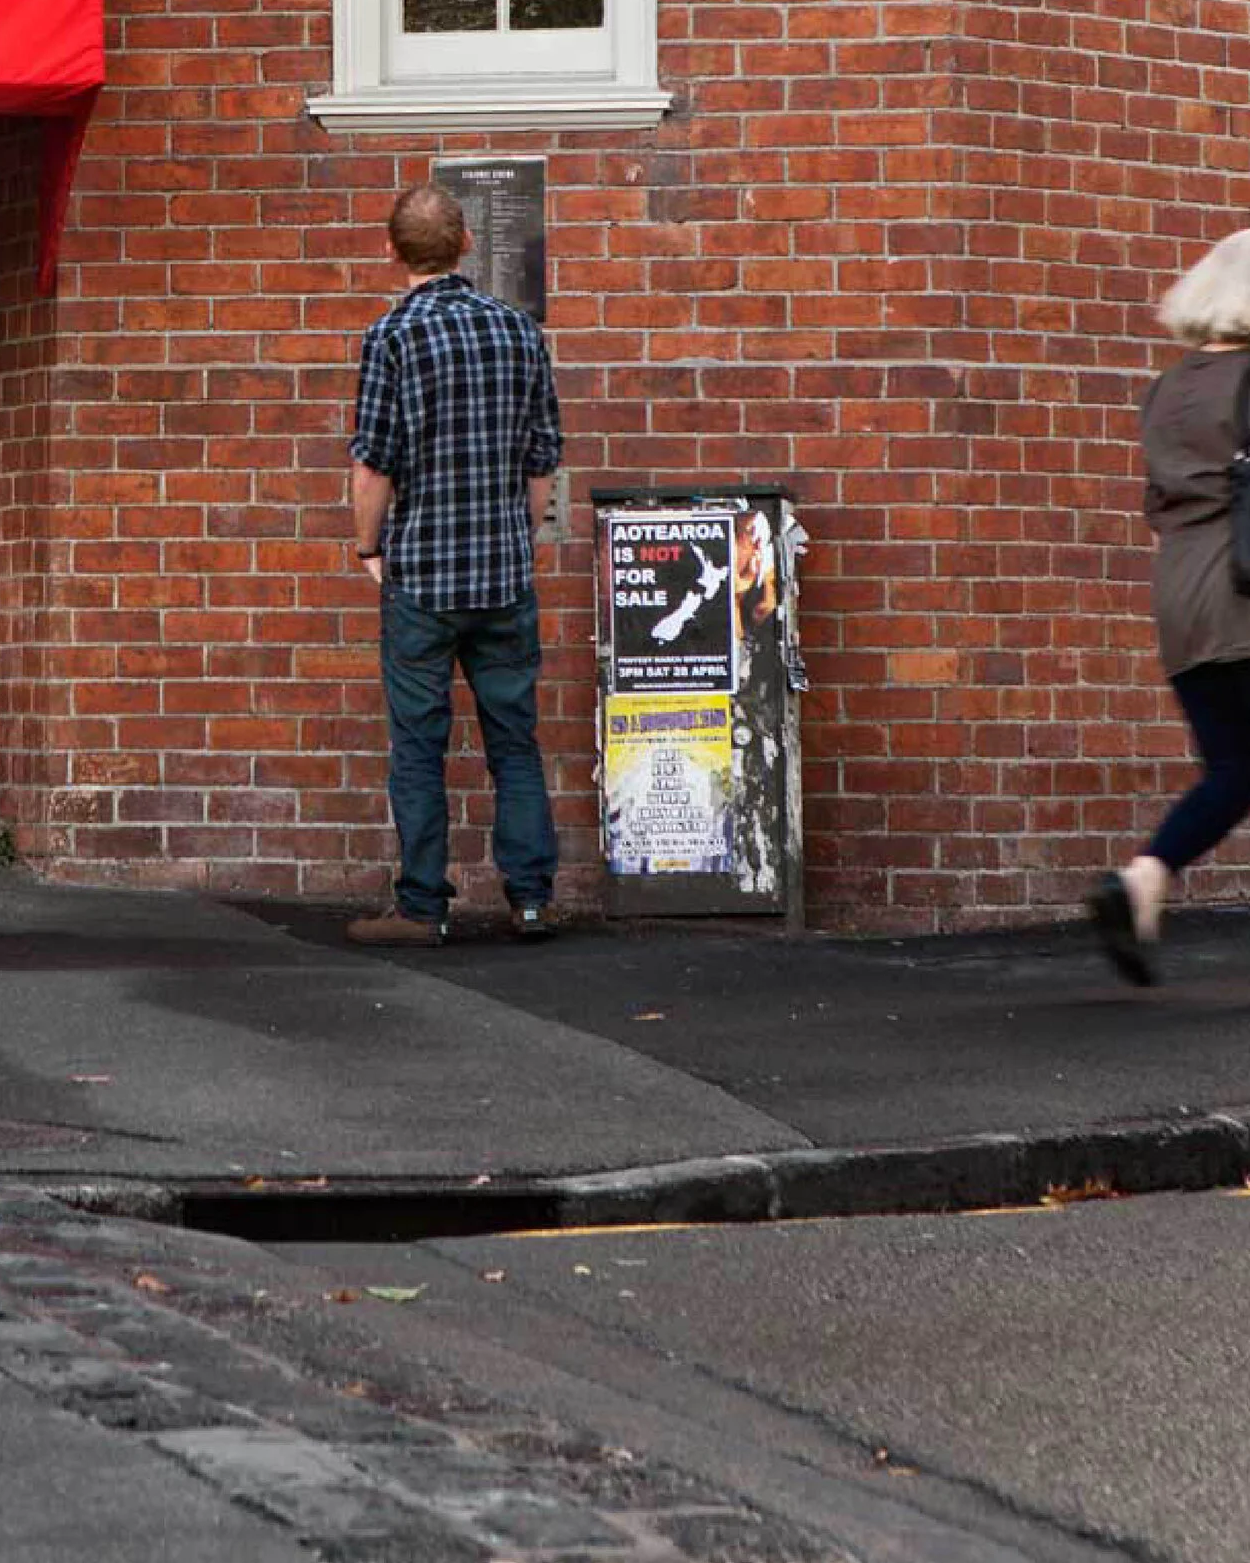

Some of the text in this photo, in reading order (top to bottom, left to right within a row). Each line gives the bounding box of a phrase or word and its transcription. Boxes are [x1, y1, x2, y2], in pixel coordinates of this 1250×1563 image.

[613, 524, 724, 541] AOTEAROA
[614, 545, 681, 563] IS NOT
[614, 569, 656, 586] FOR
[615, 590, 668, 607] SALE
[618, 667, 644, 677] 3PM
[646, 666, 669, 677] SAT
[691, 664, 728, 677] APRIL
